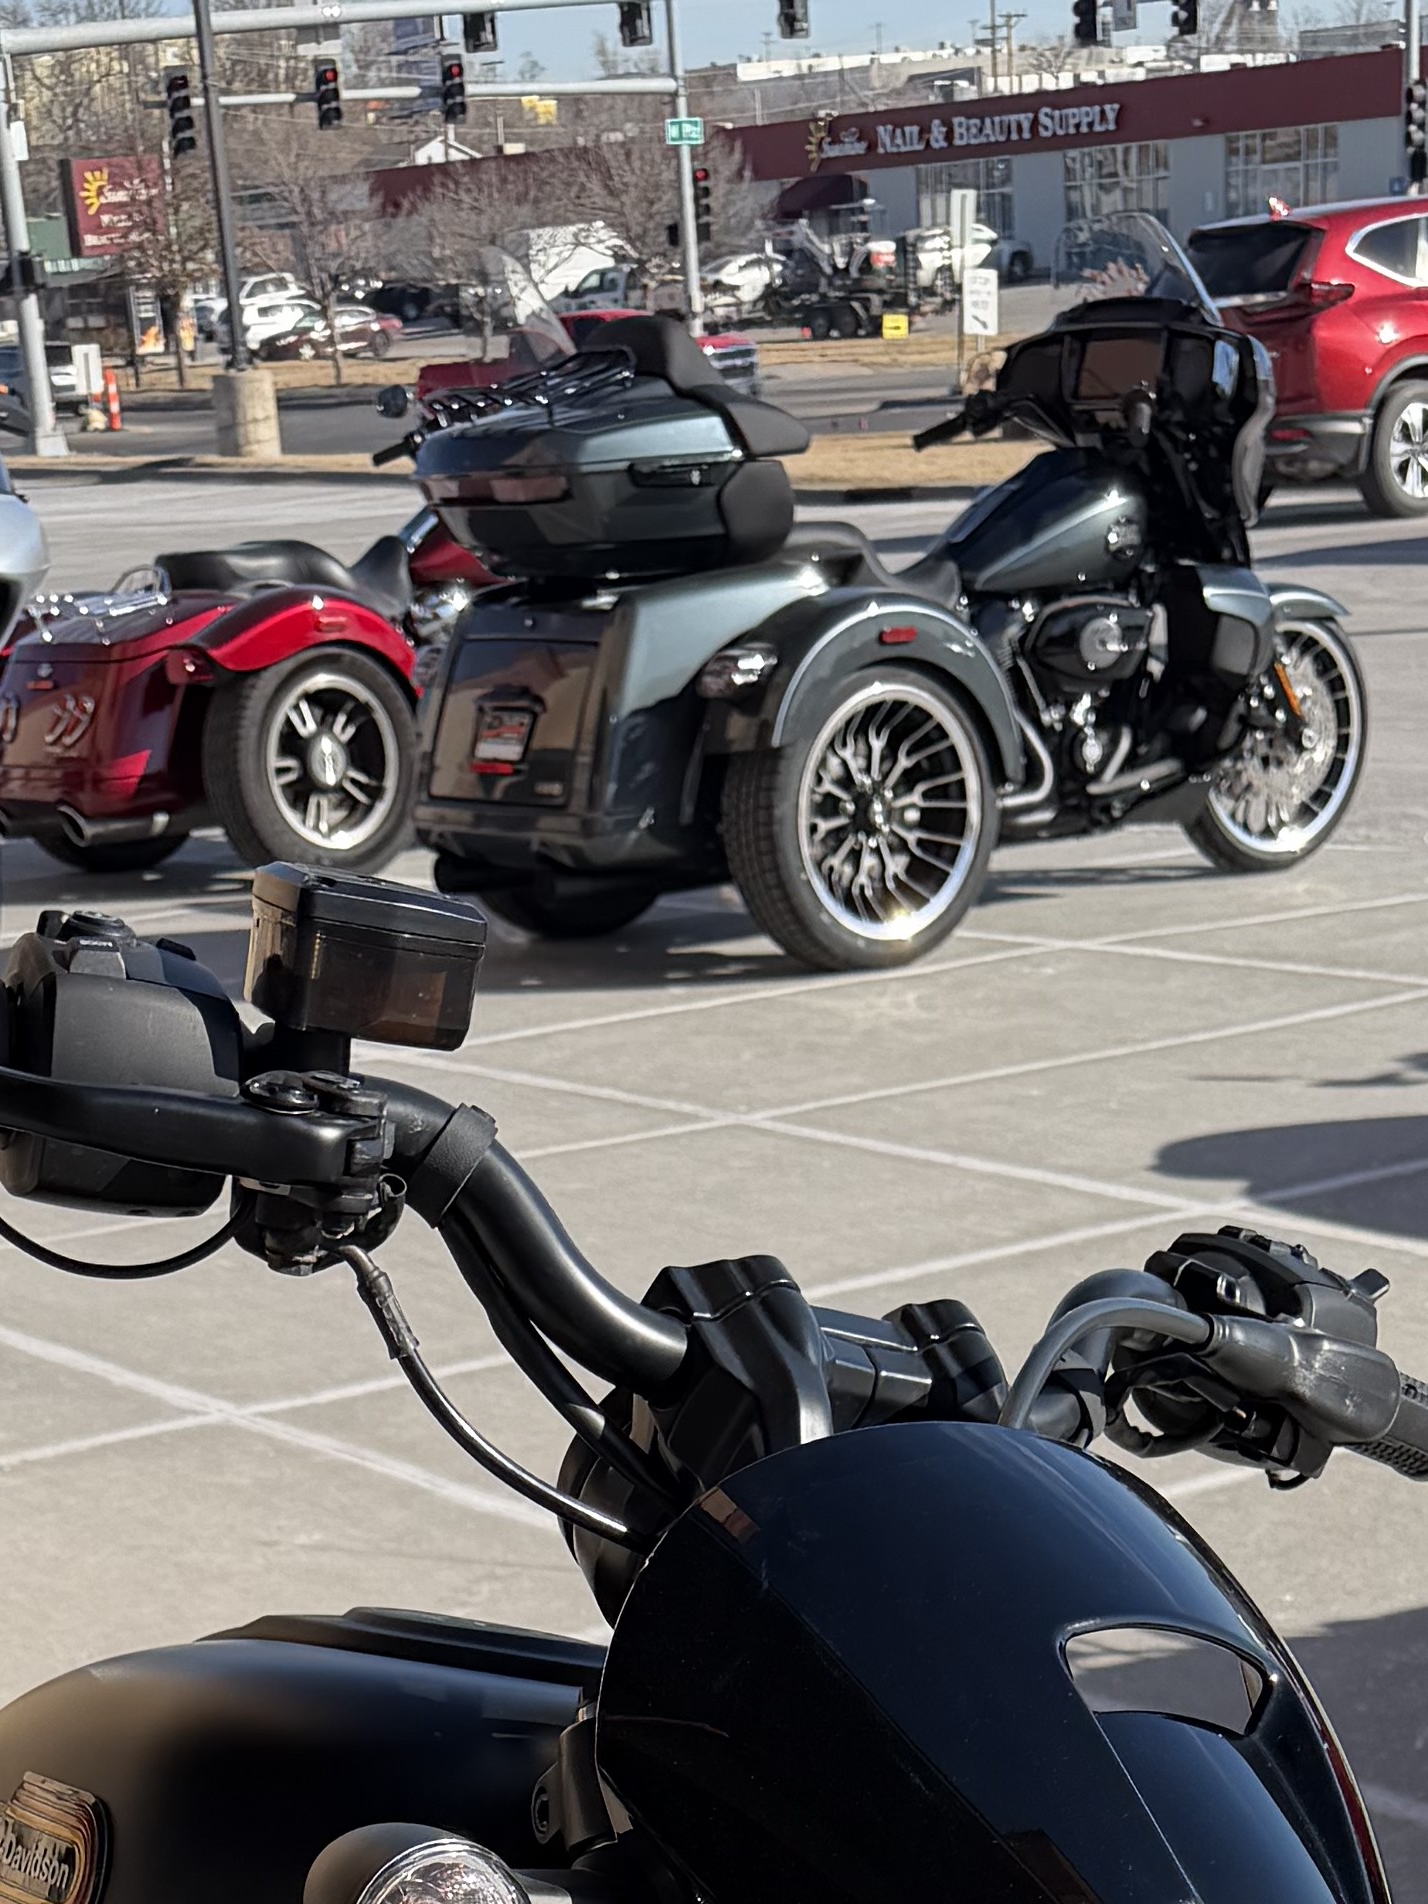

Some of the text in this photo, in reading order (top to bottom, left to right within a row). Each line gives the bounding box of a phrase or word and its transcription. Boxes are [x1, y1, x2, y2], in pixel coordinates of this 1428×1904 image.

[876, 124, 926, 154] NAIL
[928, 118, 949, 150] &
[951, 112, 1035, 147] BEAUTY
[1037, 102, 1121, 138] SUPPLY
